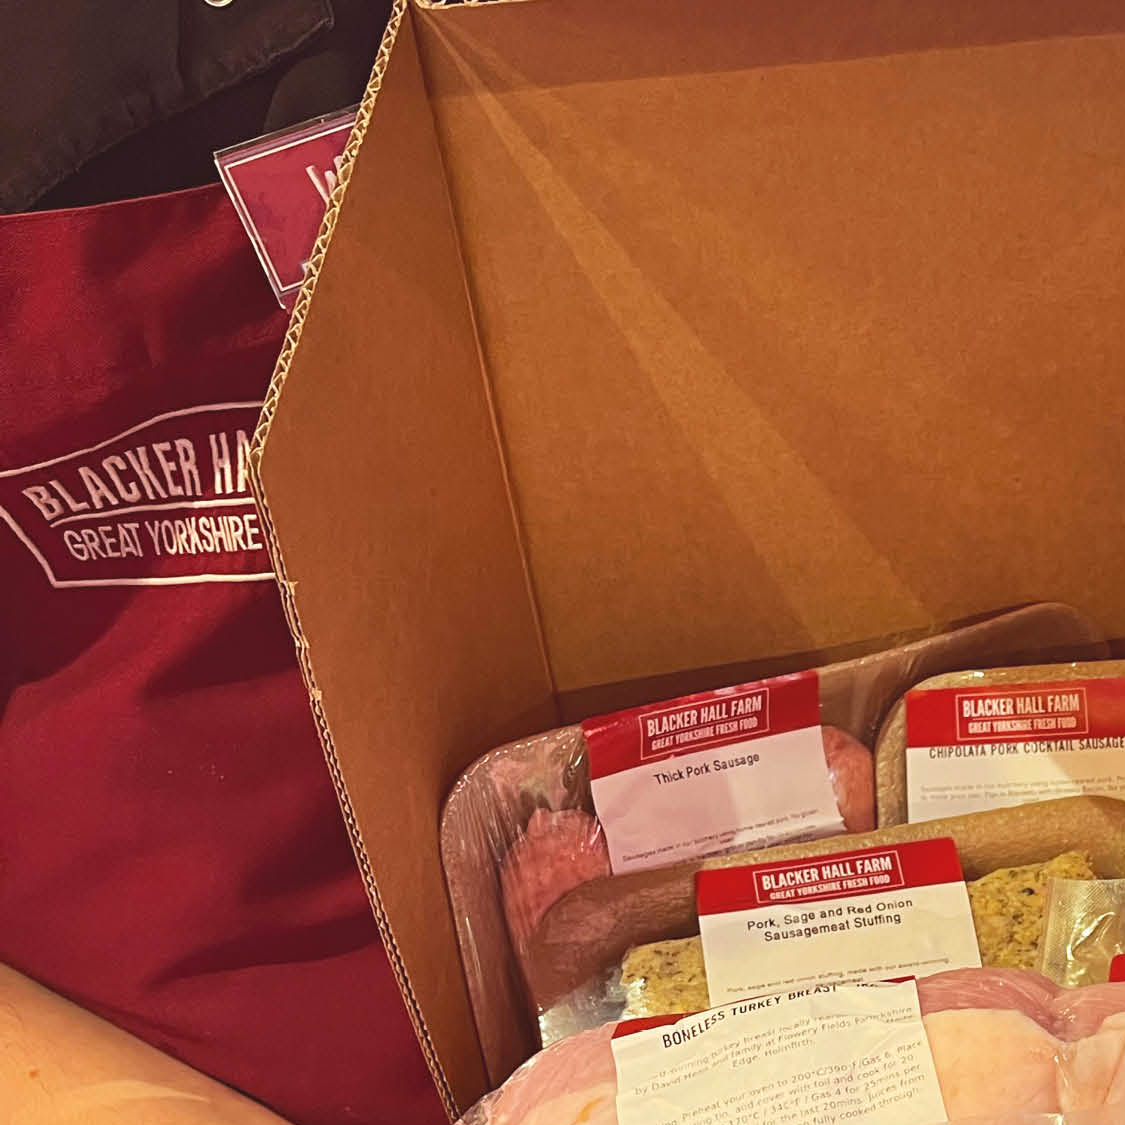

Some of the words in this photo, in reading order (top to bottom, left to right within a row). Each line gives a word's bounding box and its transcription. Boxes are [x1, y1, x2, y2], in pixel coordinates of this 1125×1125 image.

[23, 436, 202, 521] BLACKER
[64, 522, 144, 561] GREAT
[146, 514, 263, 557] YORKSHIRE
[647, 710, 698, 736] BLACKER
[701, 702, 728, 723] HALL
[730, 696, 762, 717] FARM
[963, 697, 1014, 717] BLACKER
[1016, 696, 1045, 714] HALL
[1047, 694, 1079, 712] FARM
[651, 734, 673, 751] GREAT
[675, 727, 714, 745] YORKSHIRE
[716, 721, 739, 736] FRESH
[741, 717, 758, 731] FOOD
[968, 721, 990, 734] GREAT
[993, 719, 1031, 732] YORKSHIRE
[1032, 718, 1056, 730] FRESH
[1058, 717, 1076, 728] FOOD
[929, 745, 986, 758] CHIPOLATA
[990, 744, 1018, 755] PORK
[1024, 740, 1075, 754] COCKTAIL
[654, 766, 684, 785] Thick
[686, 763, 710, 778] Pork
[714, 753, 761, 771] Sausage
[762, 868, 819, 890] BLACKER
[822, 863, 854, 882] HALL
[856, 856, 892, 876] FARM
[770, 889, 795, 900] GREAT
[798, 881, 841, 896] YORKSHIRE
[843, 878, 868, 890] FRESH
[869, 874, 890, 886] FOOD
[747, 918, 780, 931] Pork,
[784, 912, 816, 928] Sage
[820, 908, 842, 920] and
[848, 904, 872, 916] Red
[876, 899, 913, 911] Onion
[764, 920, 850, 942] Sausagemeat
[854, 913, 902, 930] Stuffing
[663, 1011, 726, 1049] BONELESS
[731, 996, 781, 1016] TURKEY
